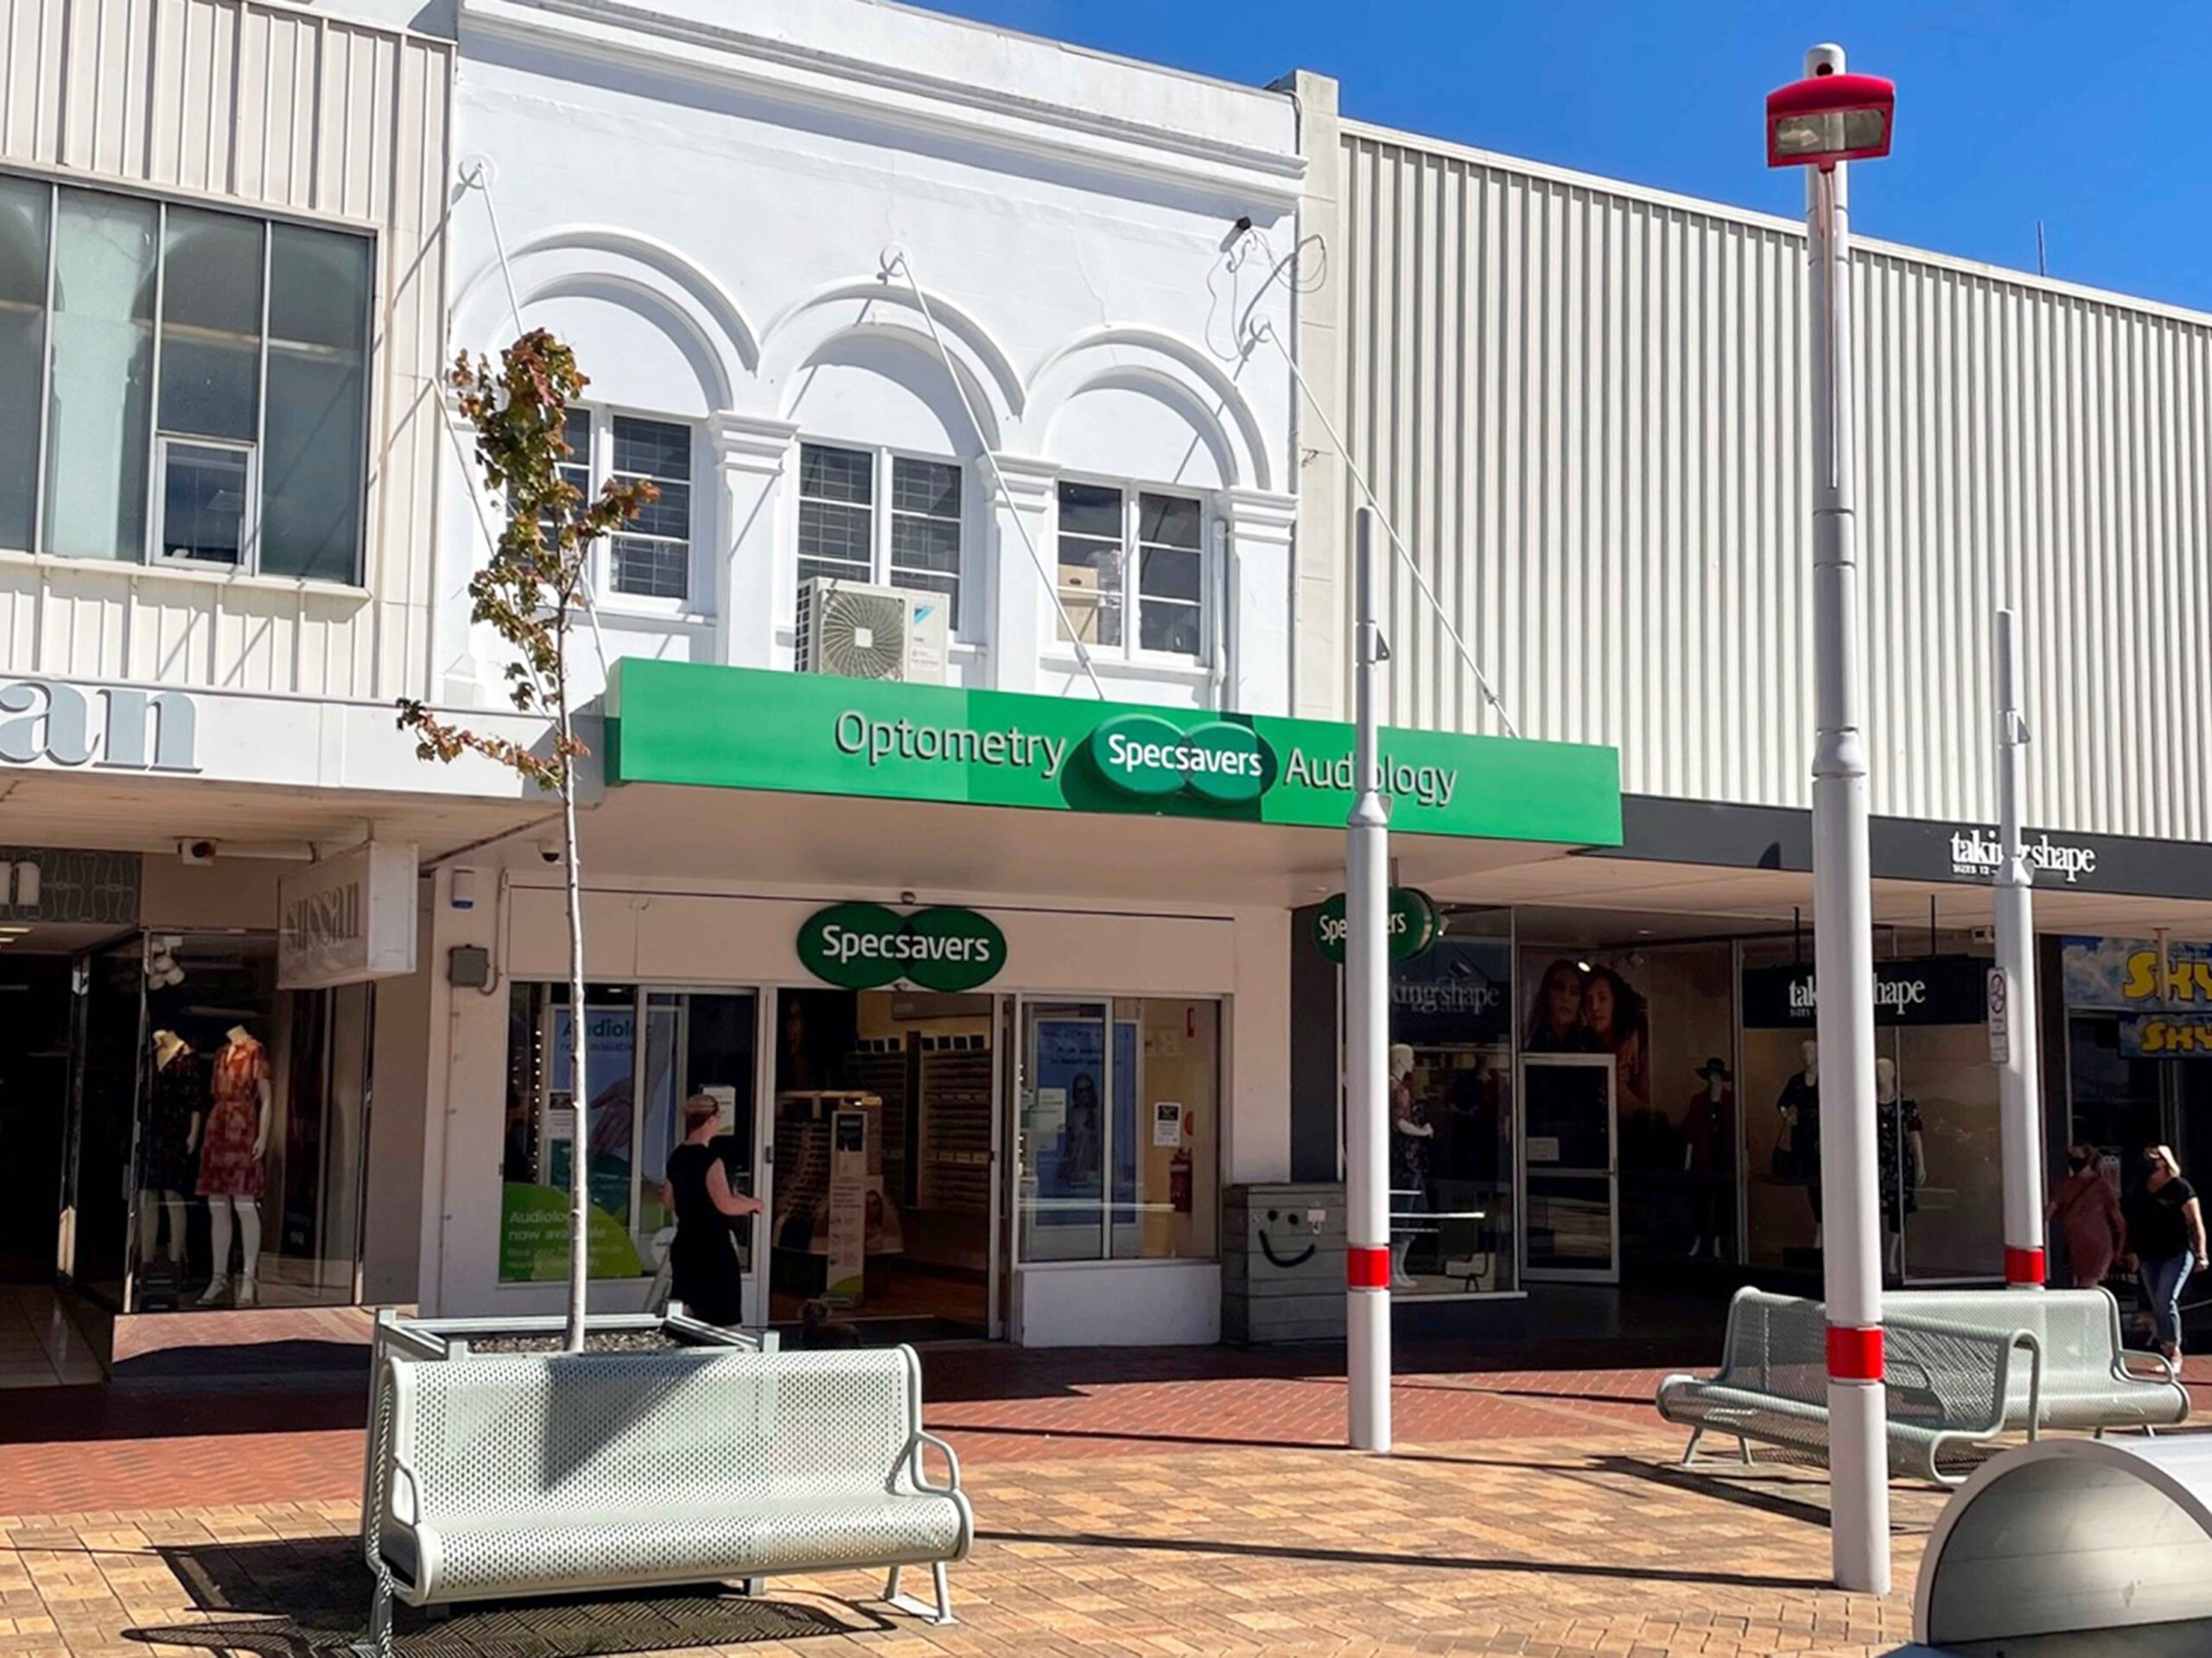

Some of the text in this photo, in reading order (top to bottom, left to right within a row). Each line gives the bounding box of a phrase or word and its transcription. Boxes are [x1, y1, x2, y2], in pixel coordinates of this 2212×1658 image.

[835, 710, 1067, 779] Optometry
[1108, 733, 1263, 777] Specsavers
[2031, 834, 2097, 883] shape
[822, 924, 990, 964] Specsavers
